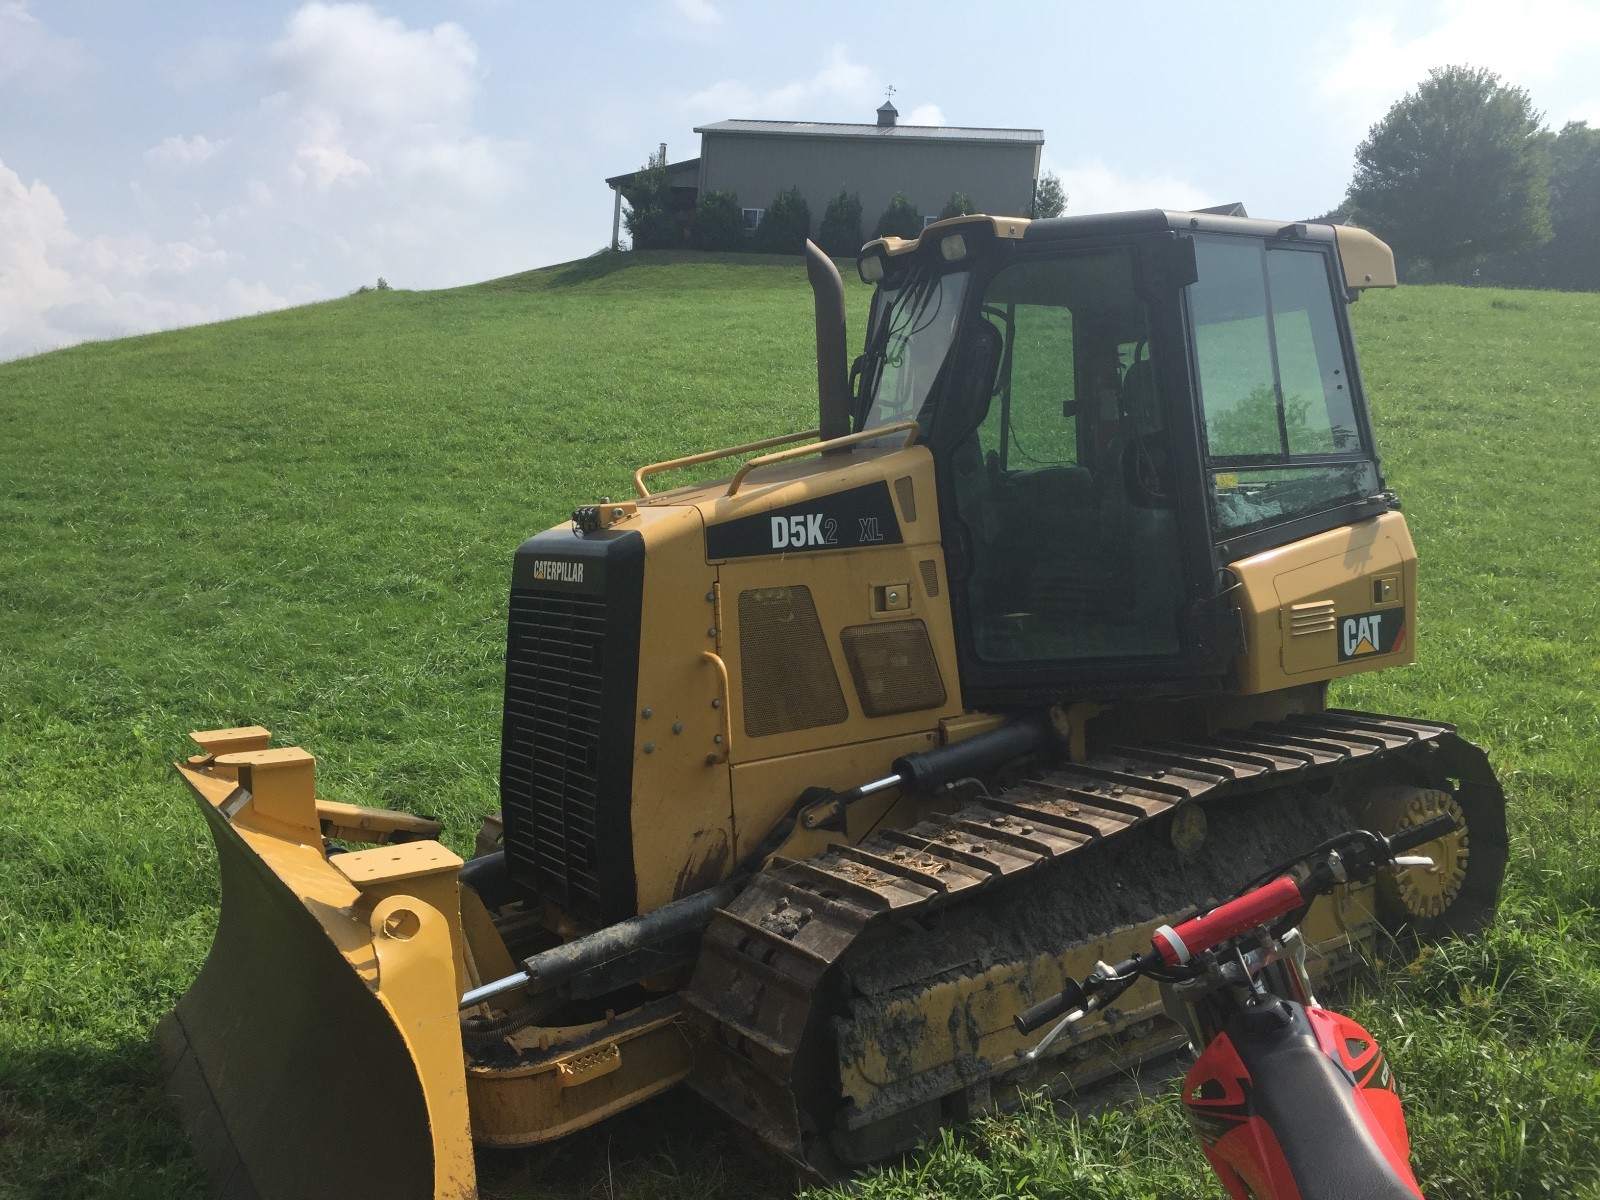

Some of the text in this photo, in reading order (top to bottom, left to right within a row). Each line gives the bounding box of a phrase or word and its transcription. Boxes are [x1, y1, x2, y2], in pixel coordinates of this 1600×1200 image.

[859, 517, 884, 542] XL
[533, 560, 584, 583] CATERPILLAR
[1343, 614, 1382, 656] CAT
